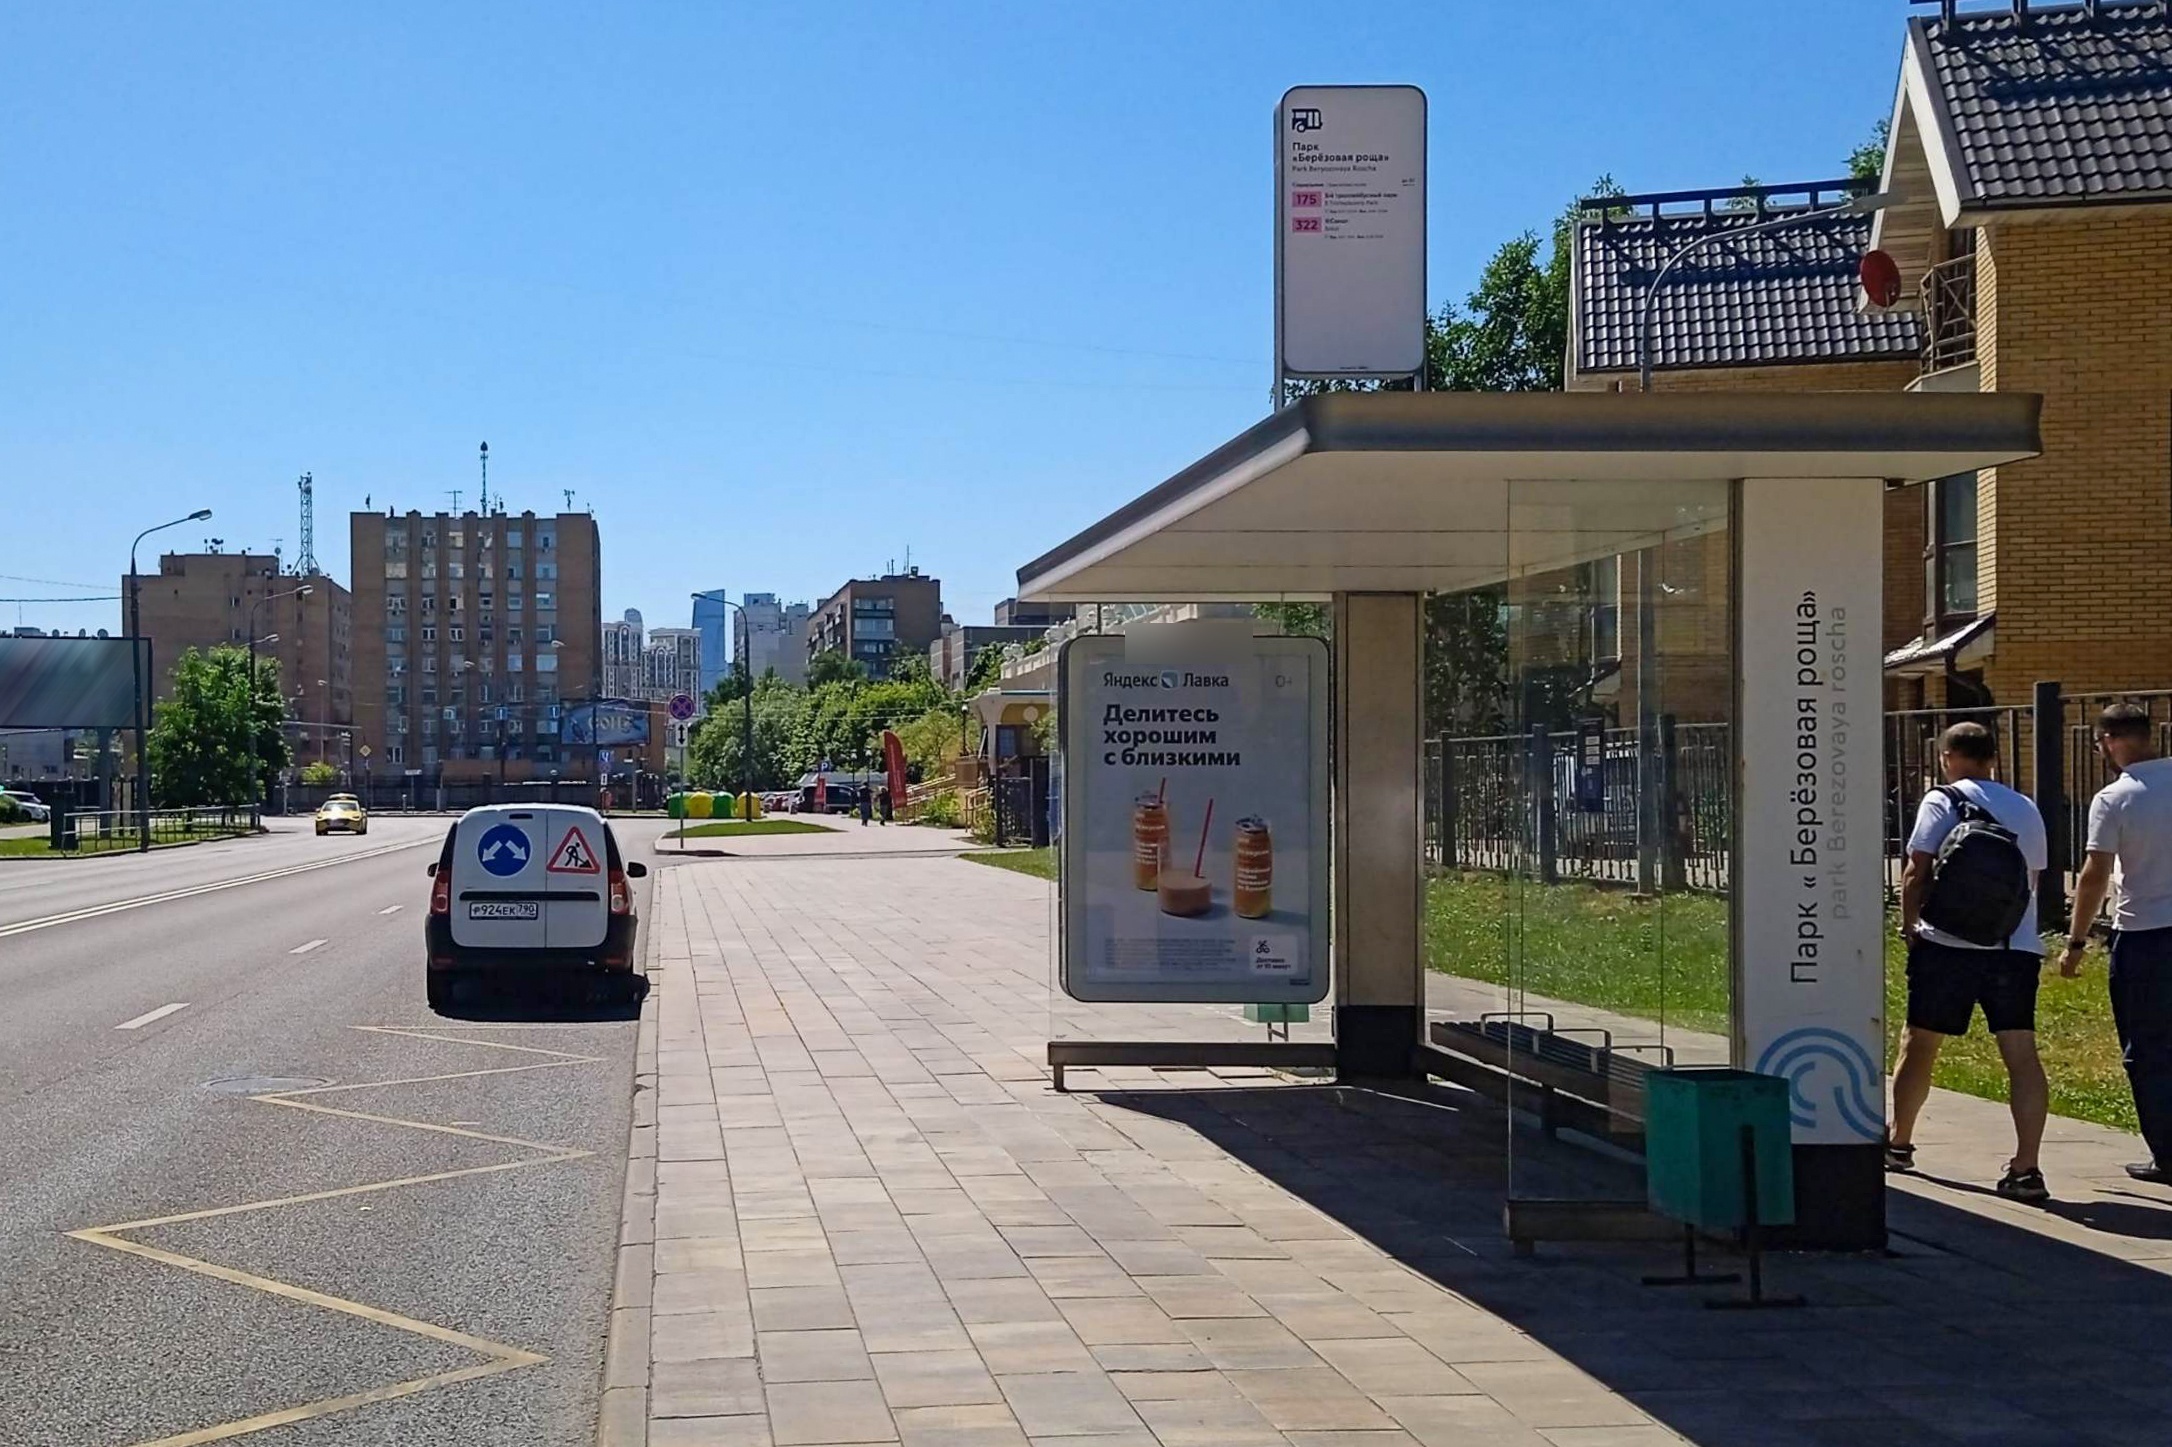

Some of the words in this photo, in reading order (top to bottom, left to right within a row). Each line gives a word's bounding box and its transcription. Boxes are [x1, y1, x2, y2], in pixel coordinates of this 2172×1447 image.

[1292, 142, 1320, 152] Парк
[1292, 153, 1354, 163] «Берёзовая
[1355, 153, 1389, 163] роща»
[1296, 194, 1317, 205] 175
[1296, 219, 1318, 231] 322
[1797, 590, 1824, 686] роща»
[1826, 606, 1846, 692] roscha
[1103, 672, 1158, 689] Яндекс
[1182, 672, 1229, 688] Лавка
[1103, 703, 1220, 726] Делитесь
[1103, 730, 1217, 748] хорошим
[1103, 752, 1117, 766] с
[1121, 747, 1241, 767] близкими
[1790, 698, 1823, 865] Берёзовая
[1826, 701, 1850, 851] Berezovaya
[1827, 862, 1850, 920] park
[473, 904, 516, 916] Р924ЕК
[1790, 901, 1824, 983] Парк
